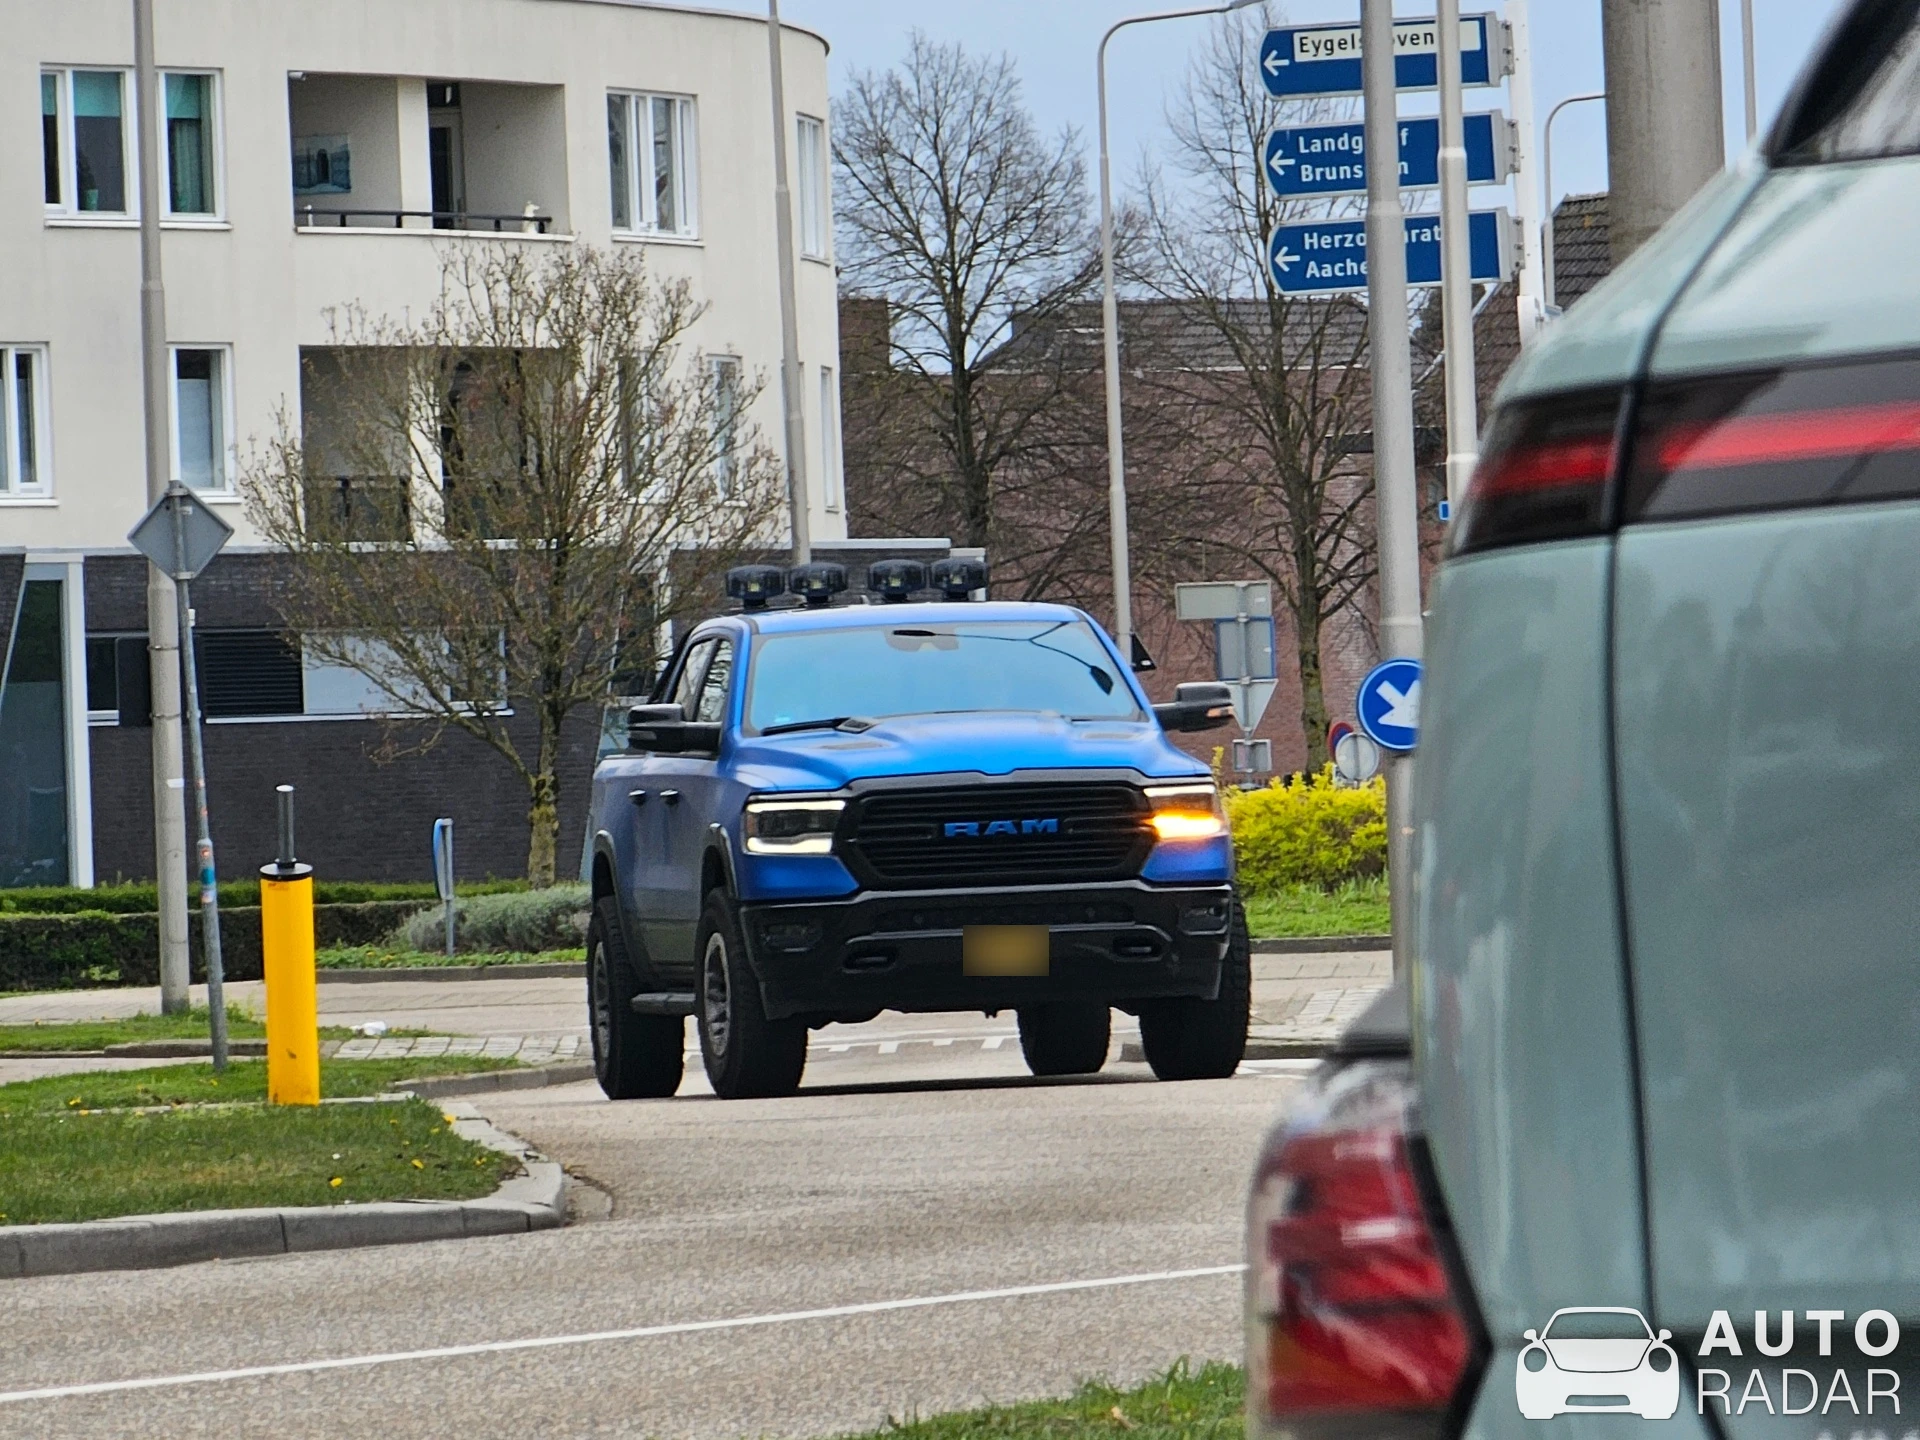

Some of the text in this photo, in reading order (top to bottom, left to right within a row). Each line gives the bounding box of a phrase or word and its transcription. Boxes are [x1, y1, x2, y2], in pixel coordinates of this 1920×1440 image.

[1299, 31, 1434, 56] Eygelven
[1298, 128, 1409, 154] Landgf
[1303, 225, 1443, 250] Herzorat
[1306, 257, 1369, 279] Aache
[945, 818, 1058, 837] RAM
